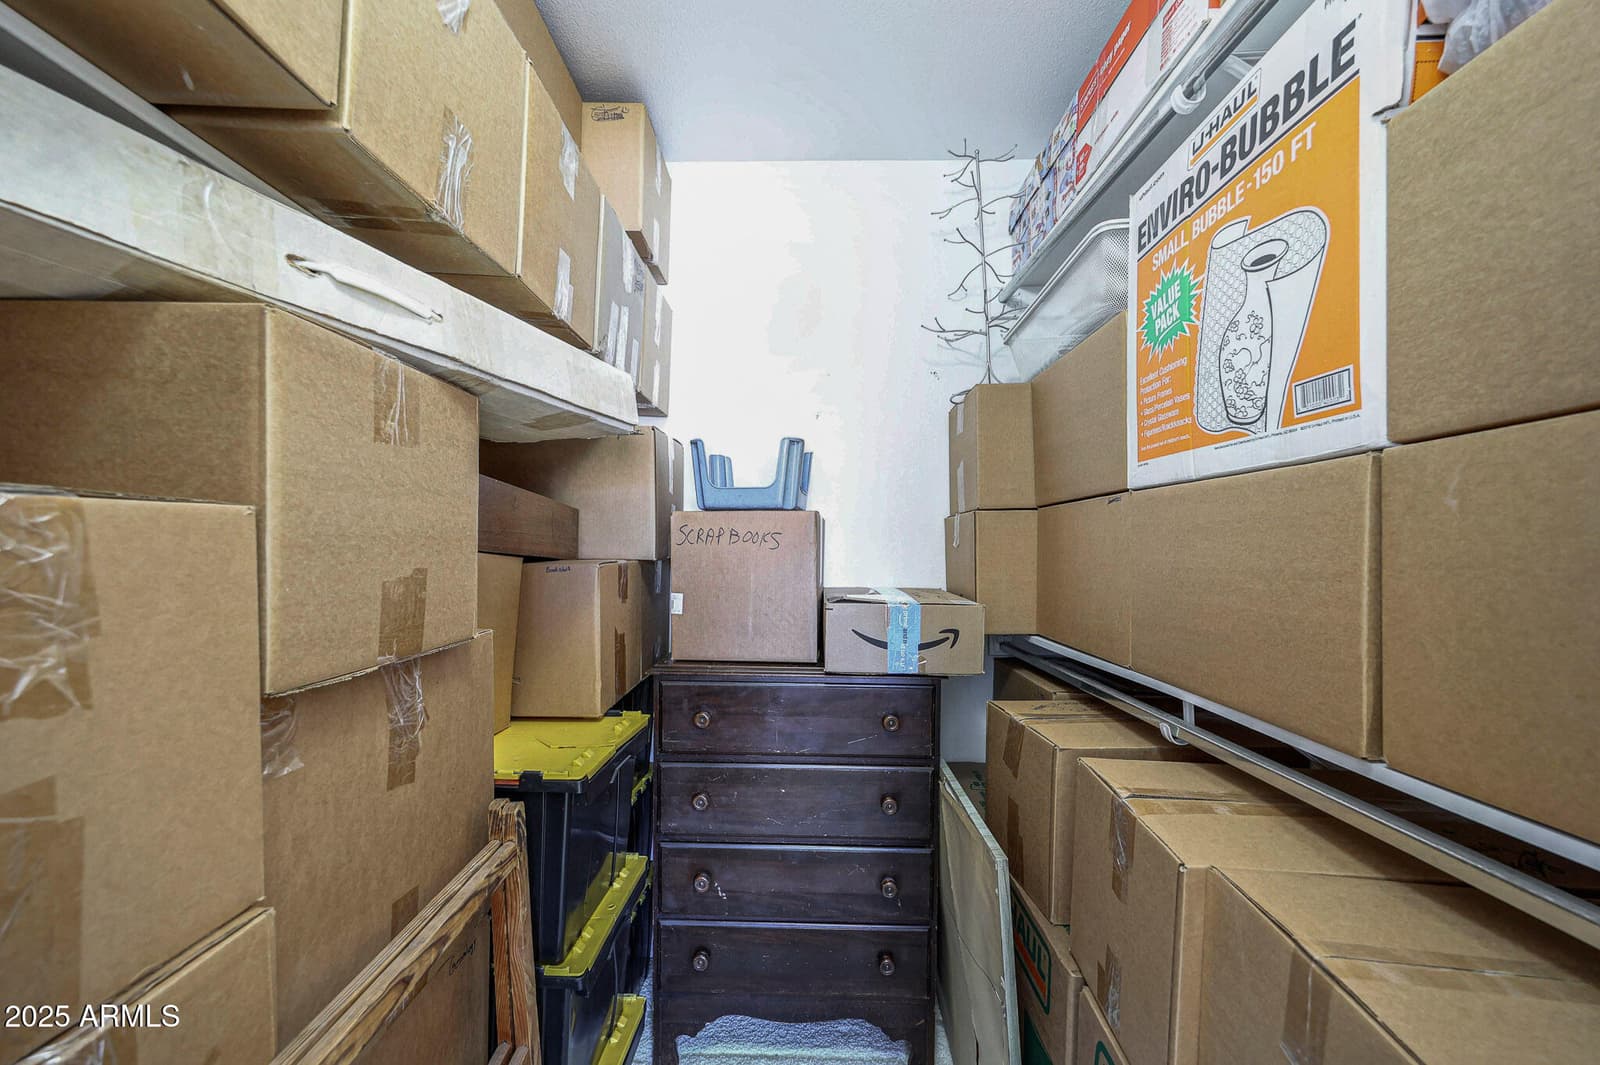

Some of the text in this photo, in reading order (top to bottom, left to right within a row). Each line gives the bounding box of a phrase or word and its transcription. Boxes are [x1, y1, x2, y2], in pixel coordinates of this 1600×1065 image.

[1138, 19, 1356, 254] ENVIRO-BUBBLE
[1152, 236, 1190, 272] SMALL
[1290, 121, 1317, 163] FT
[1150, 279, 1182, 320] VALUE
[1154, 303, 1180, 337] PACK
